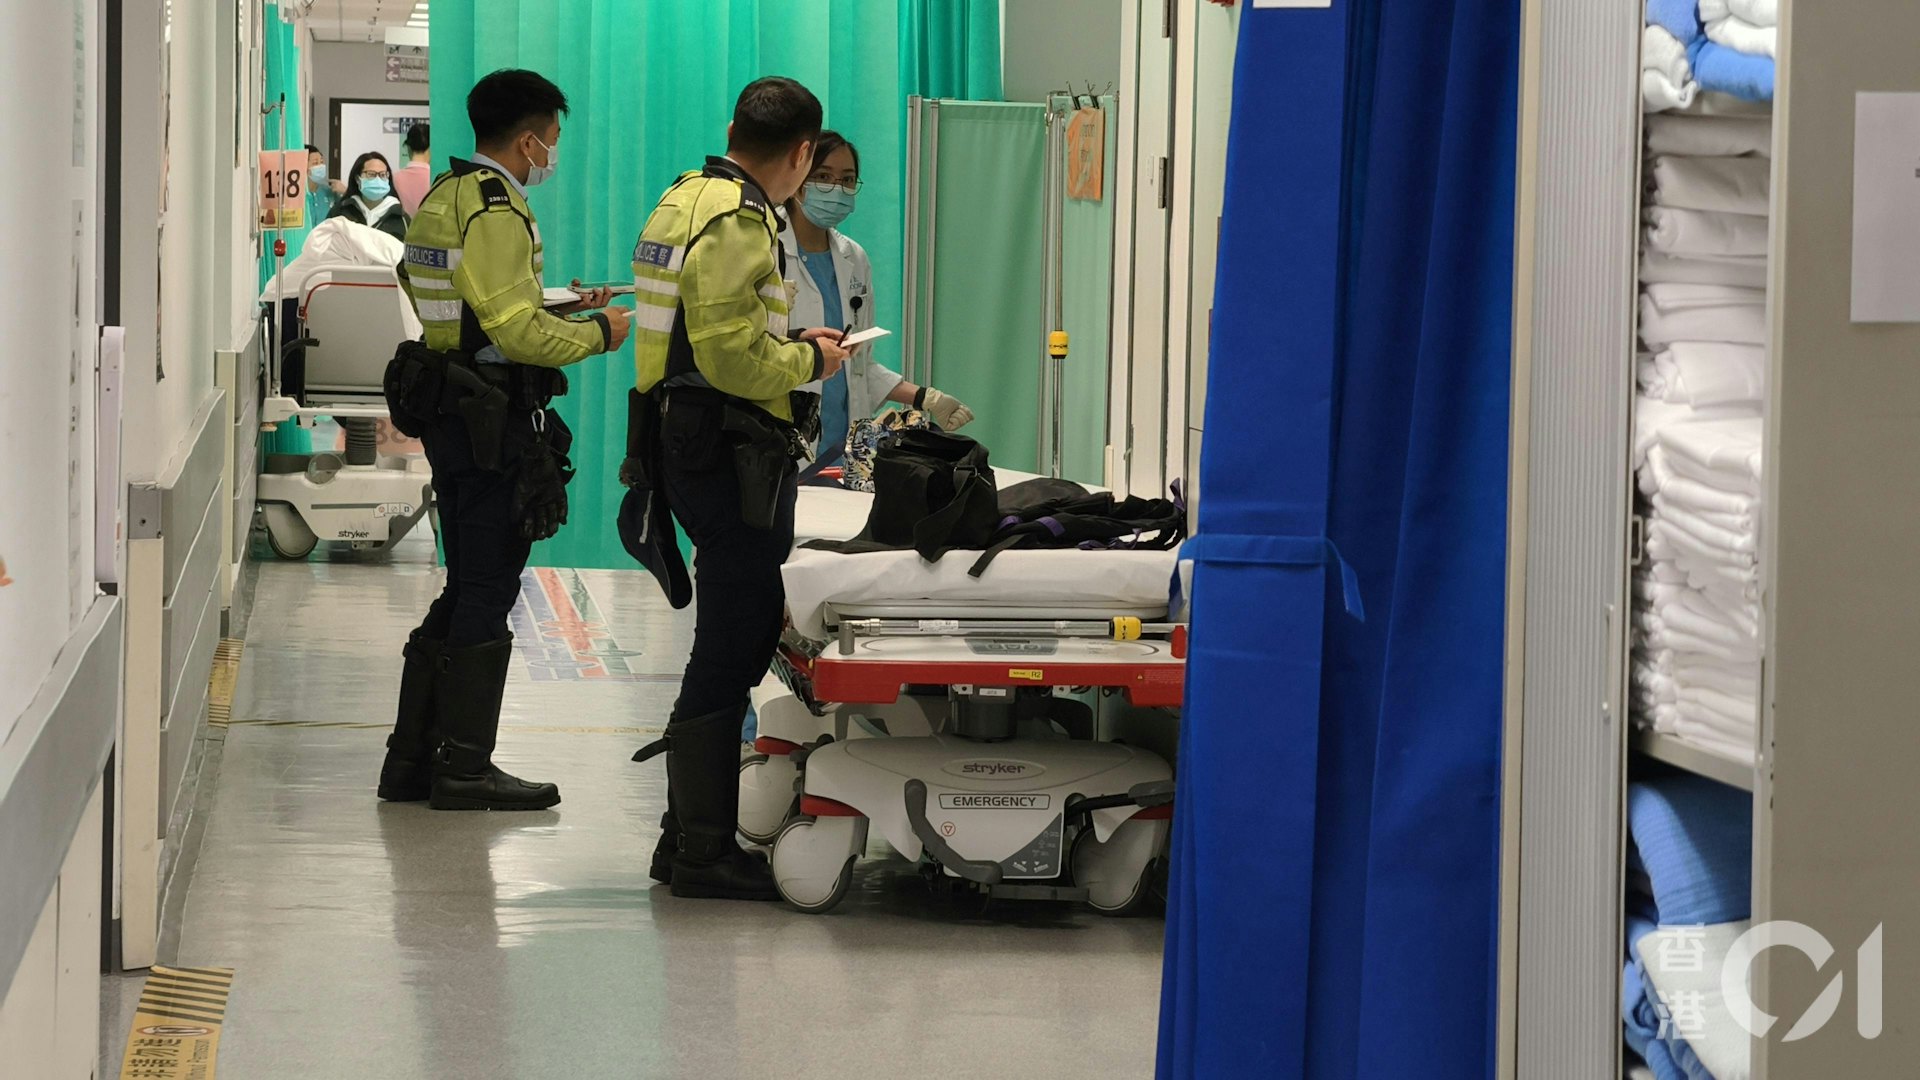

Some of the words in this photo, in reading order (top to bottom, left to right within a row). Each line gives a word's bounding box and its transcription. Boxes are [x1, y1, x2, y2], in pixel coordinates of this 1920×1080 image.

[338, 530, 369, 539] stryker
[962, 763, 1026, 775] stryker
[953, 796, 1036, 807] EMERGENCY
